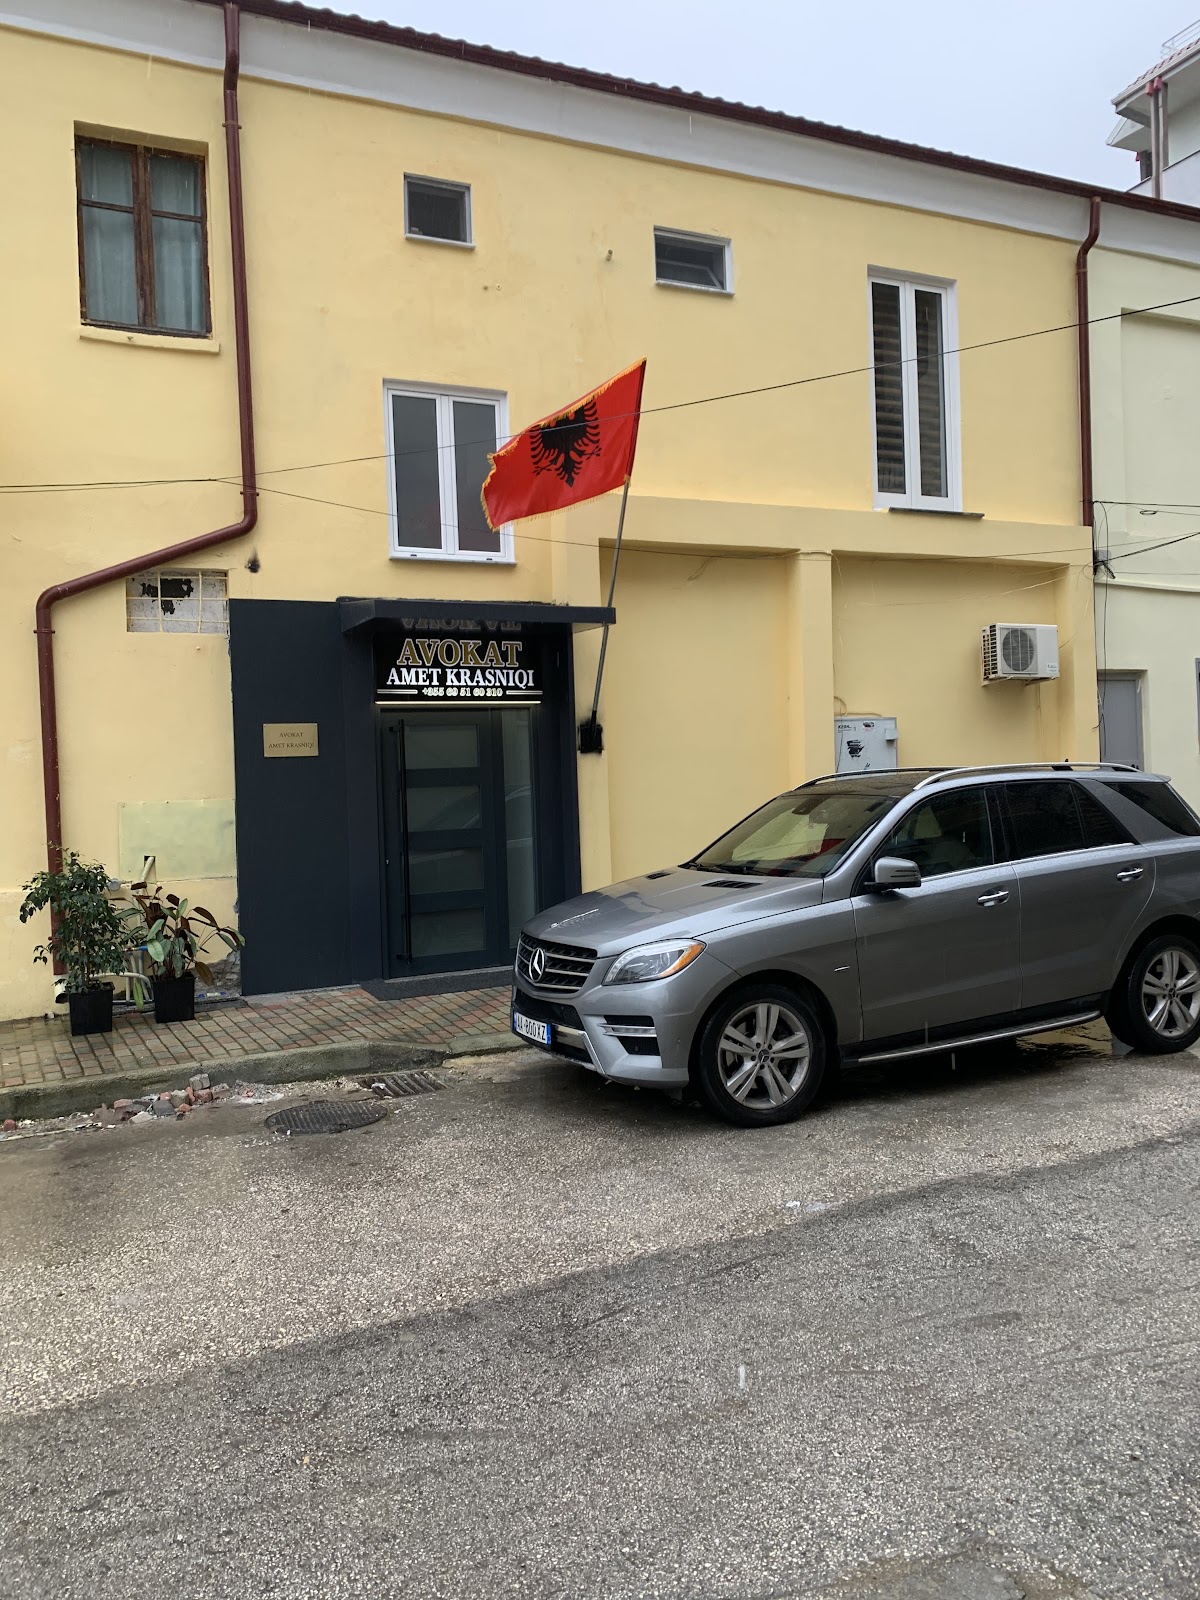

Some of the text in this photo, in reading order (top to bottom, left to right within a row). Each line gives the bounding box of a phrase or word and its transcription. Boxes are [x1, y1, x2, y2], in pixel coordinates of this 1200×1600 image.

[397, 638, 523, 667] AVOKAT
[386, 667, 534, 689] AMET KRASNIQI
